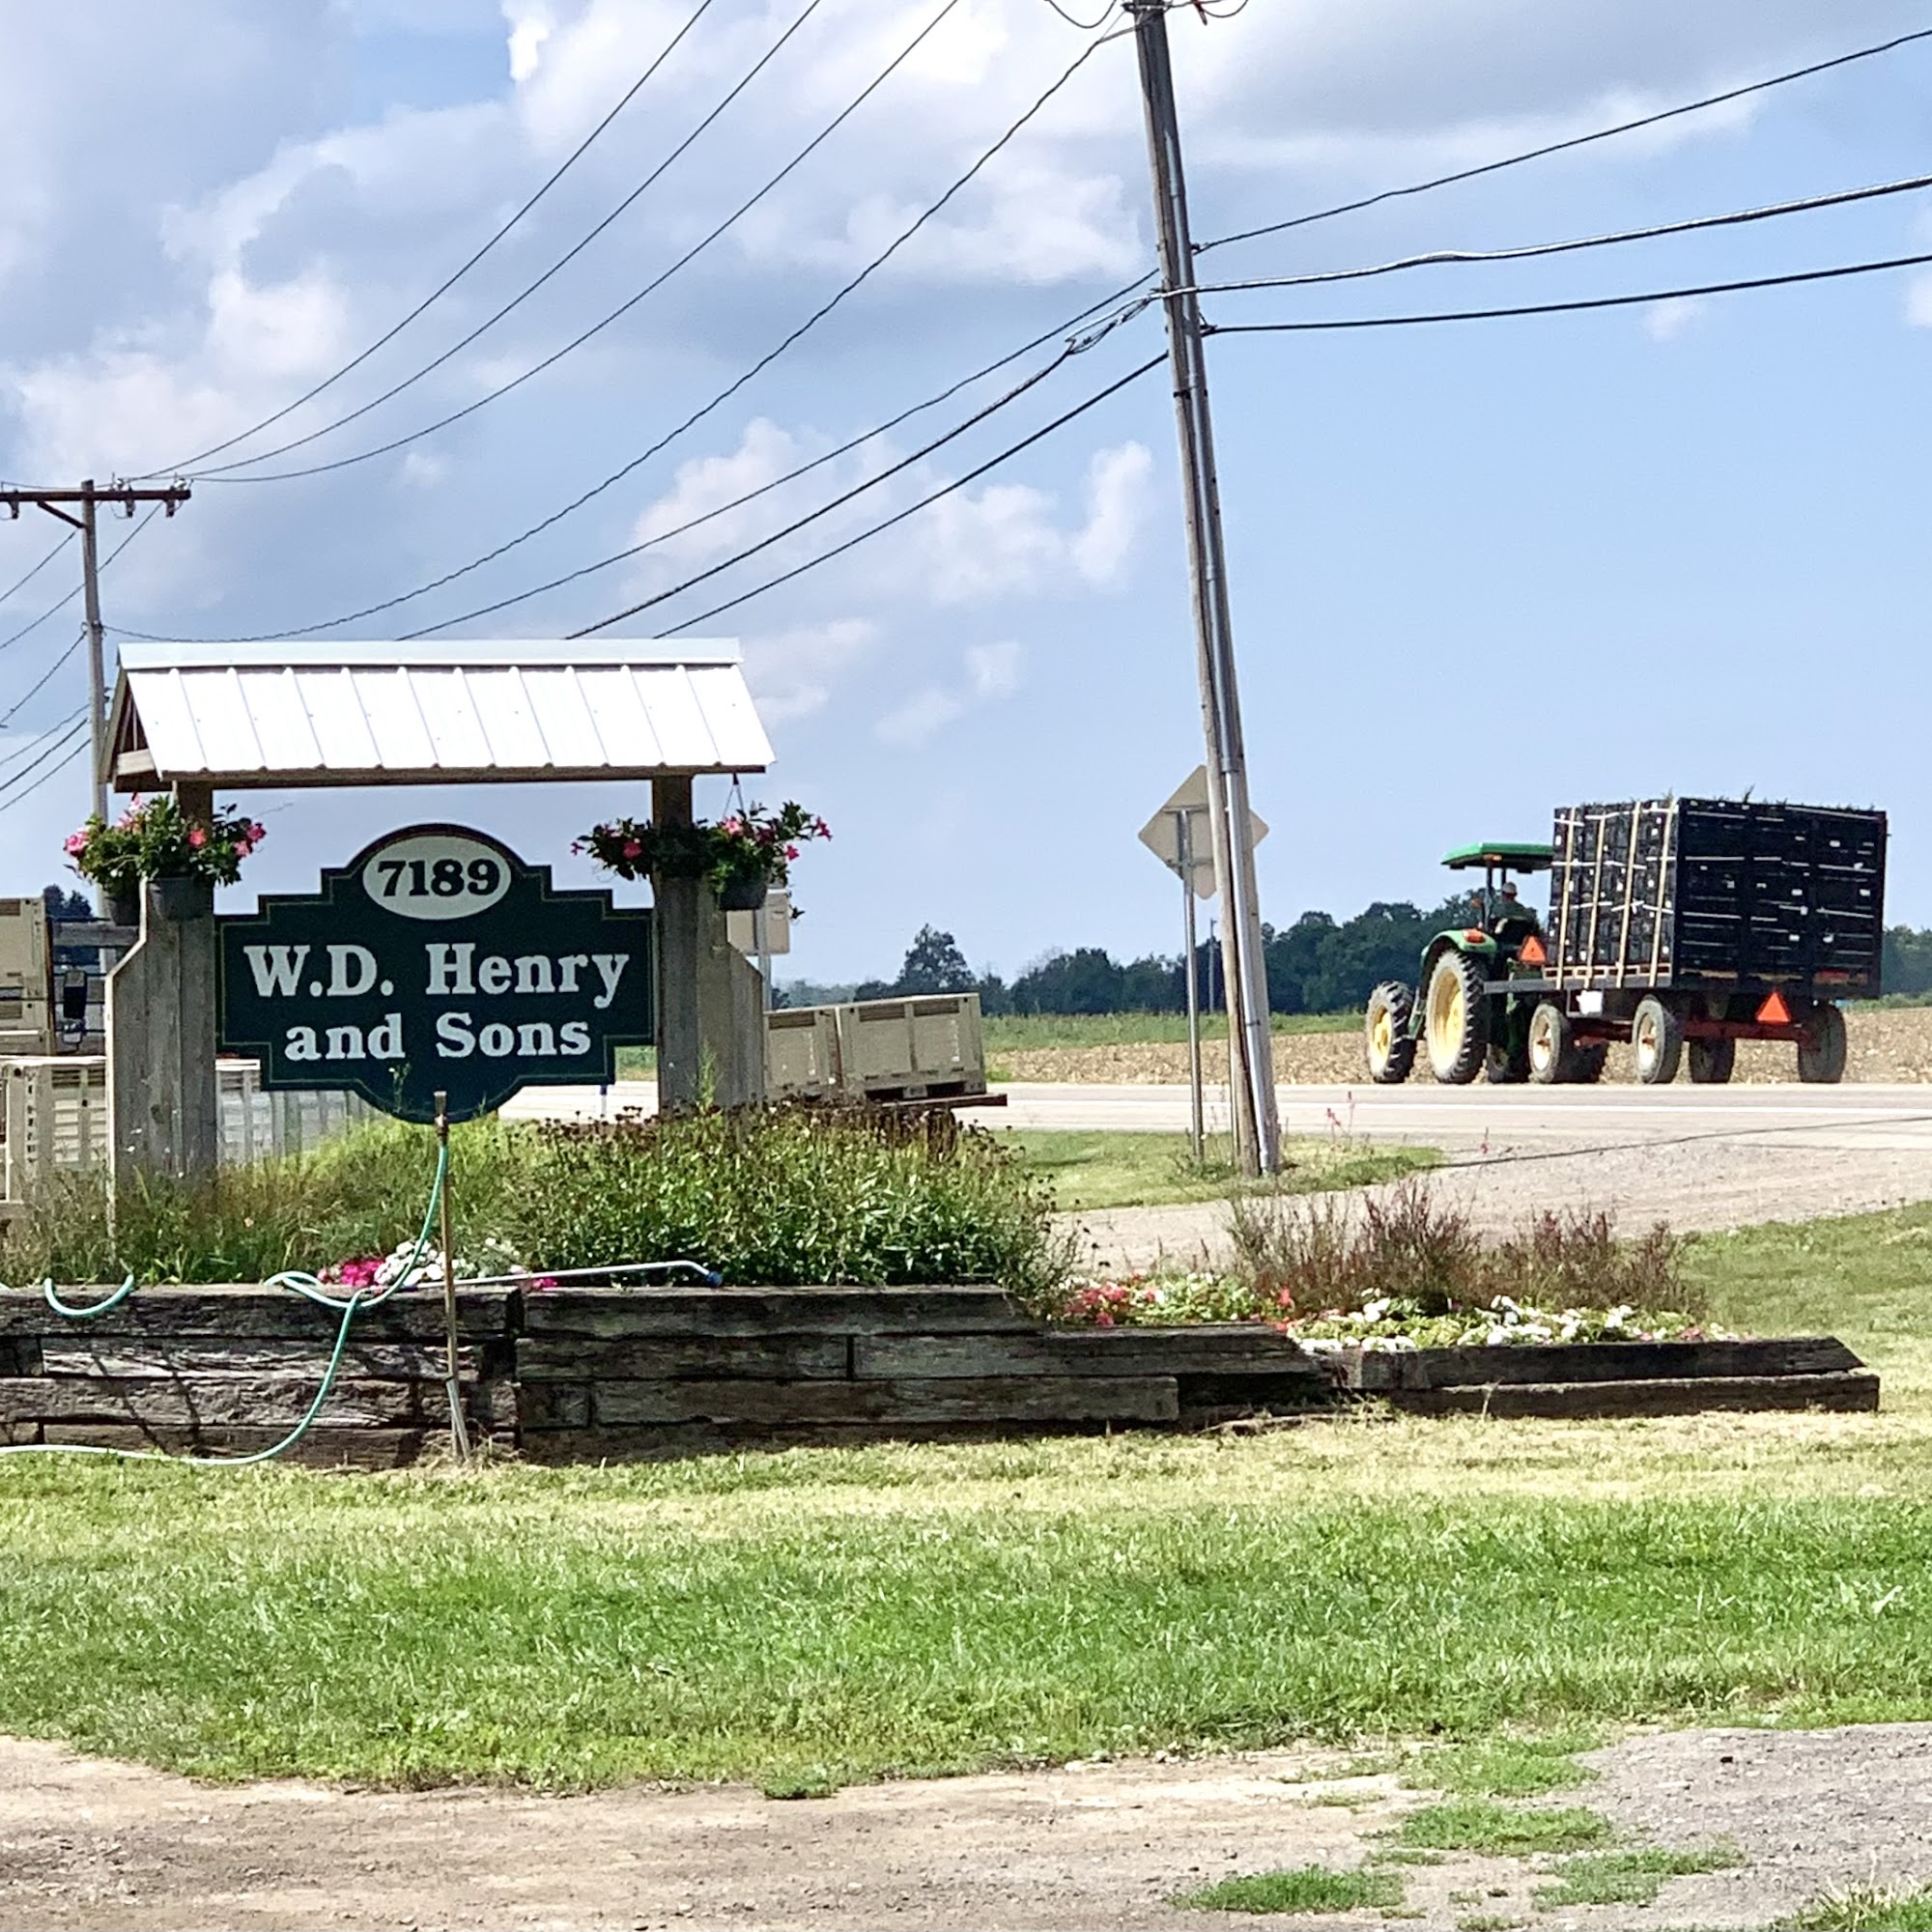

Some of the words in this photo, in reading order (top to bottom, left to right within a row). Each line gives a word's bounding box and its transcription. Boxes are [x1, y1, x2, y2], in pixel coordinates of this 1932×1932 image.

[377, 858, 501, 898] 7189
[242, 944, 395, 998] W.D.
[425, 942, 631, 1009] Henry
[284, 1012, 406, 1062] and
[435, 1011, 592, 1058] Sons
